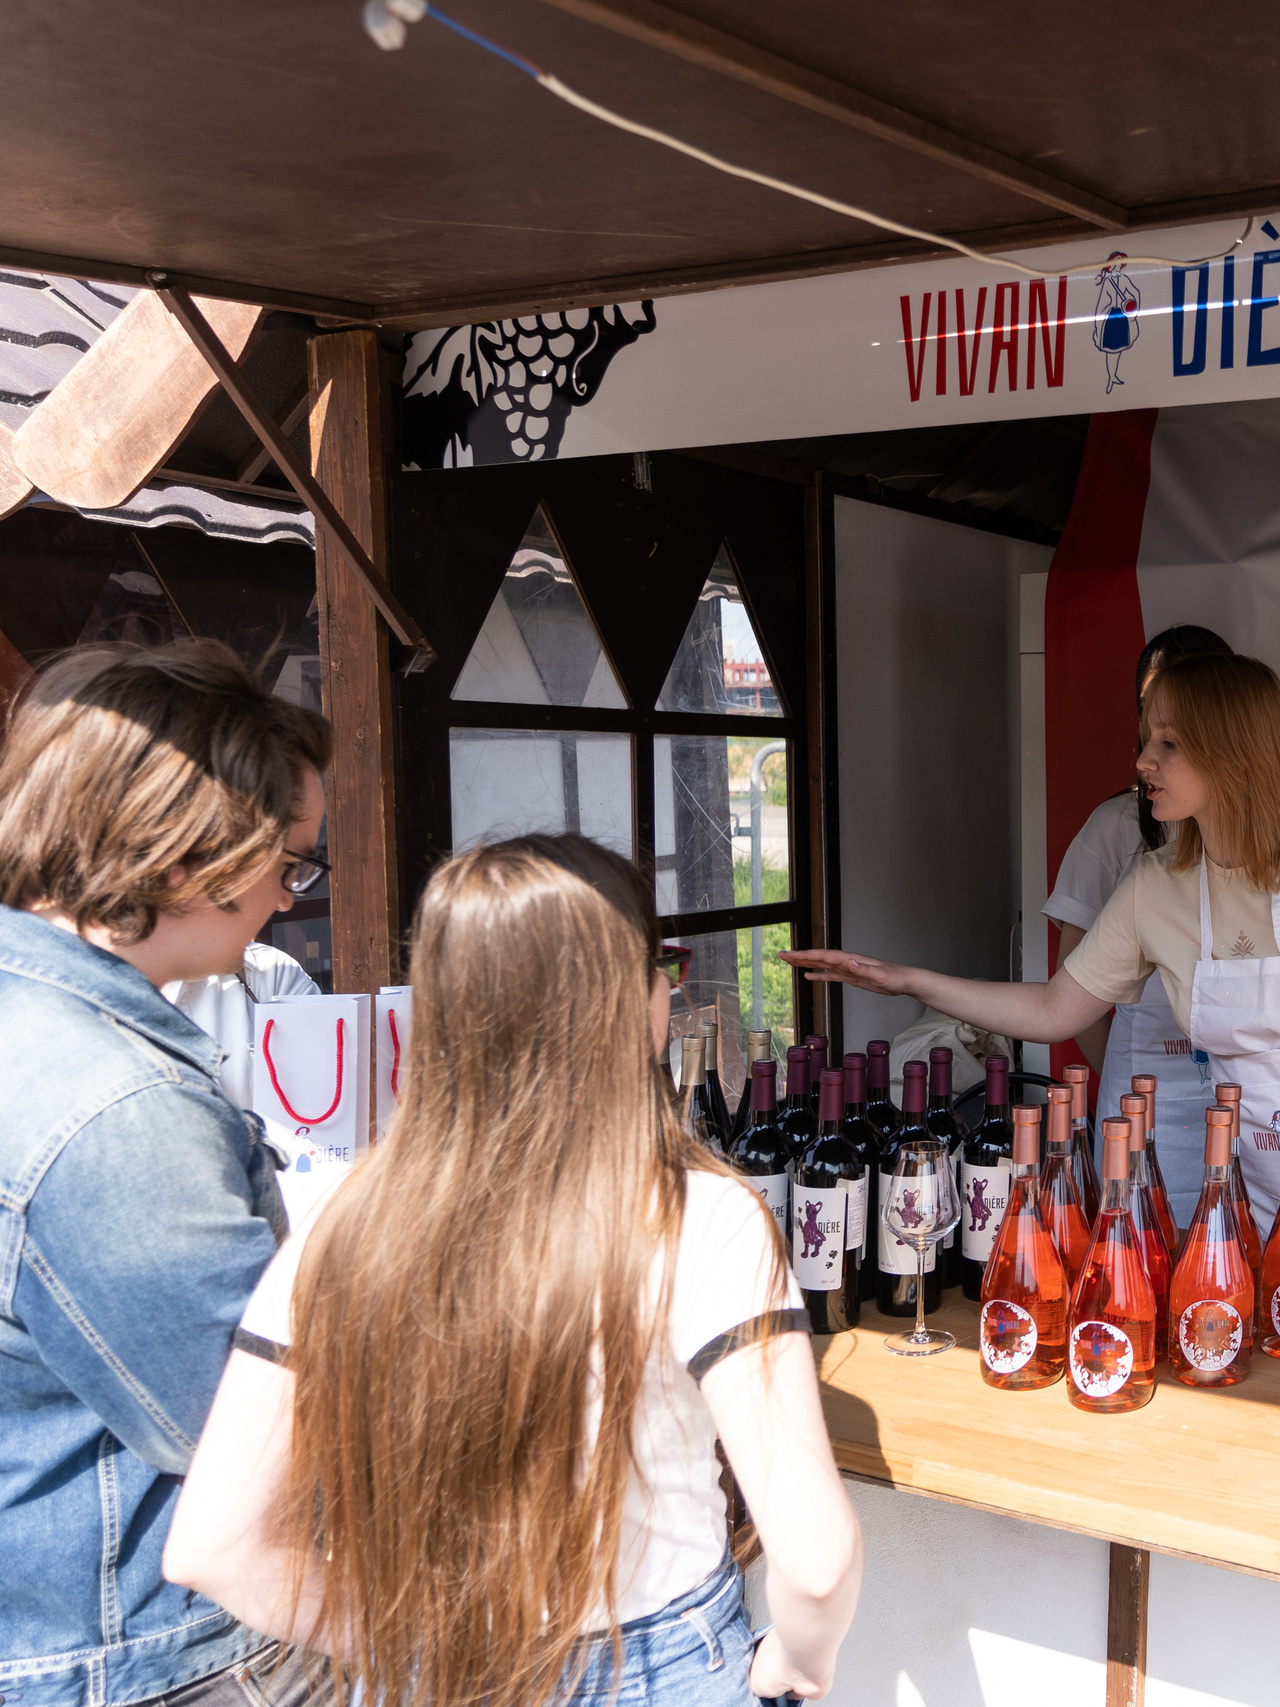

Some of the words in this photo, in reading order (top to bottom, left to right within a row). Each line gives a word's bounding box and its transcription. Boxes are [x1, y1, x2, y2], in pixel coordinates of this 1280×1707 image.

[900, 276, 1067, 402] VIVAN
[1163, 1039, 1192, 1056] VIVAN
[1253, 1131, 1280, 1151] VIVAN
[818, 1219, 841, 1234] DIÈRE
